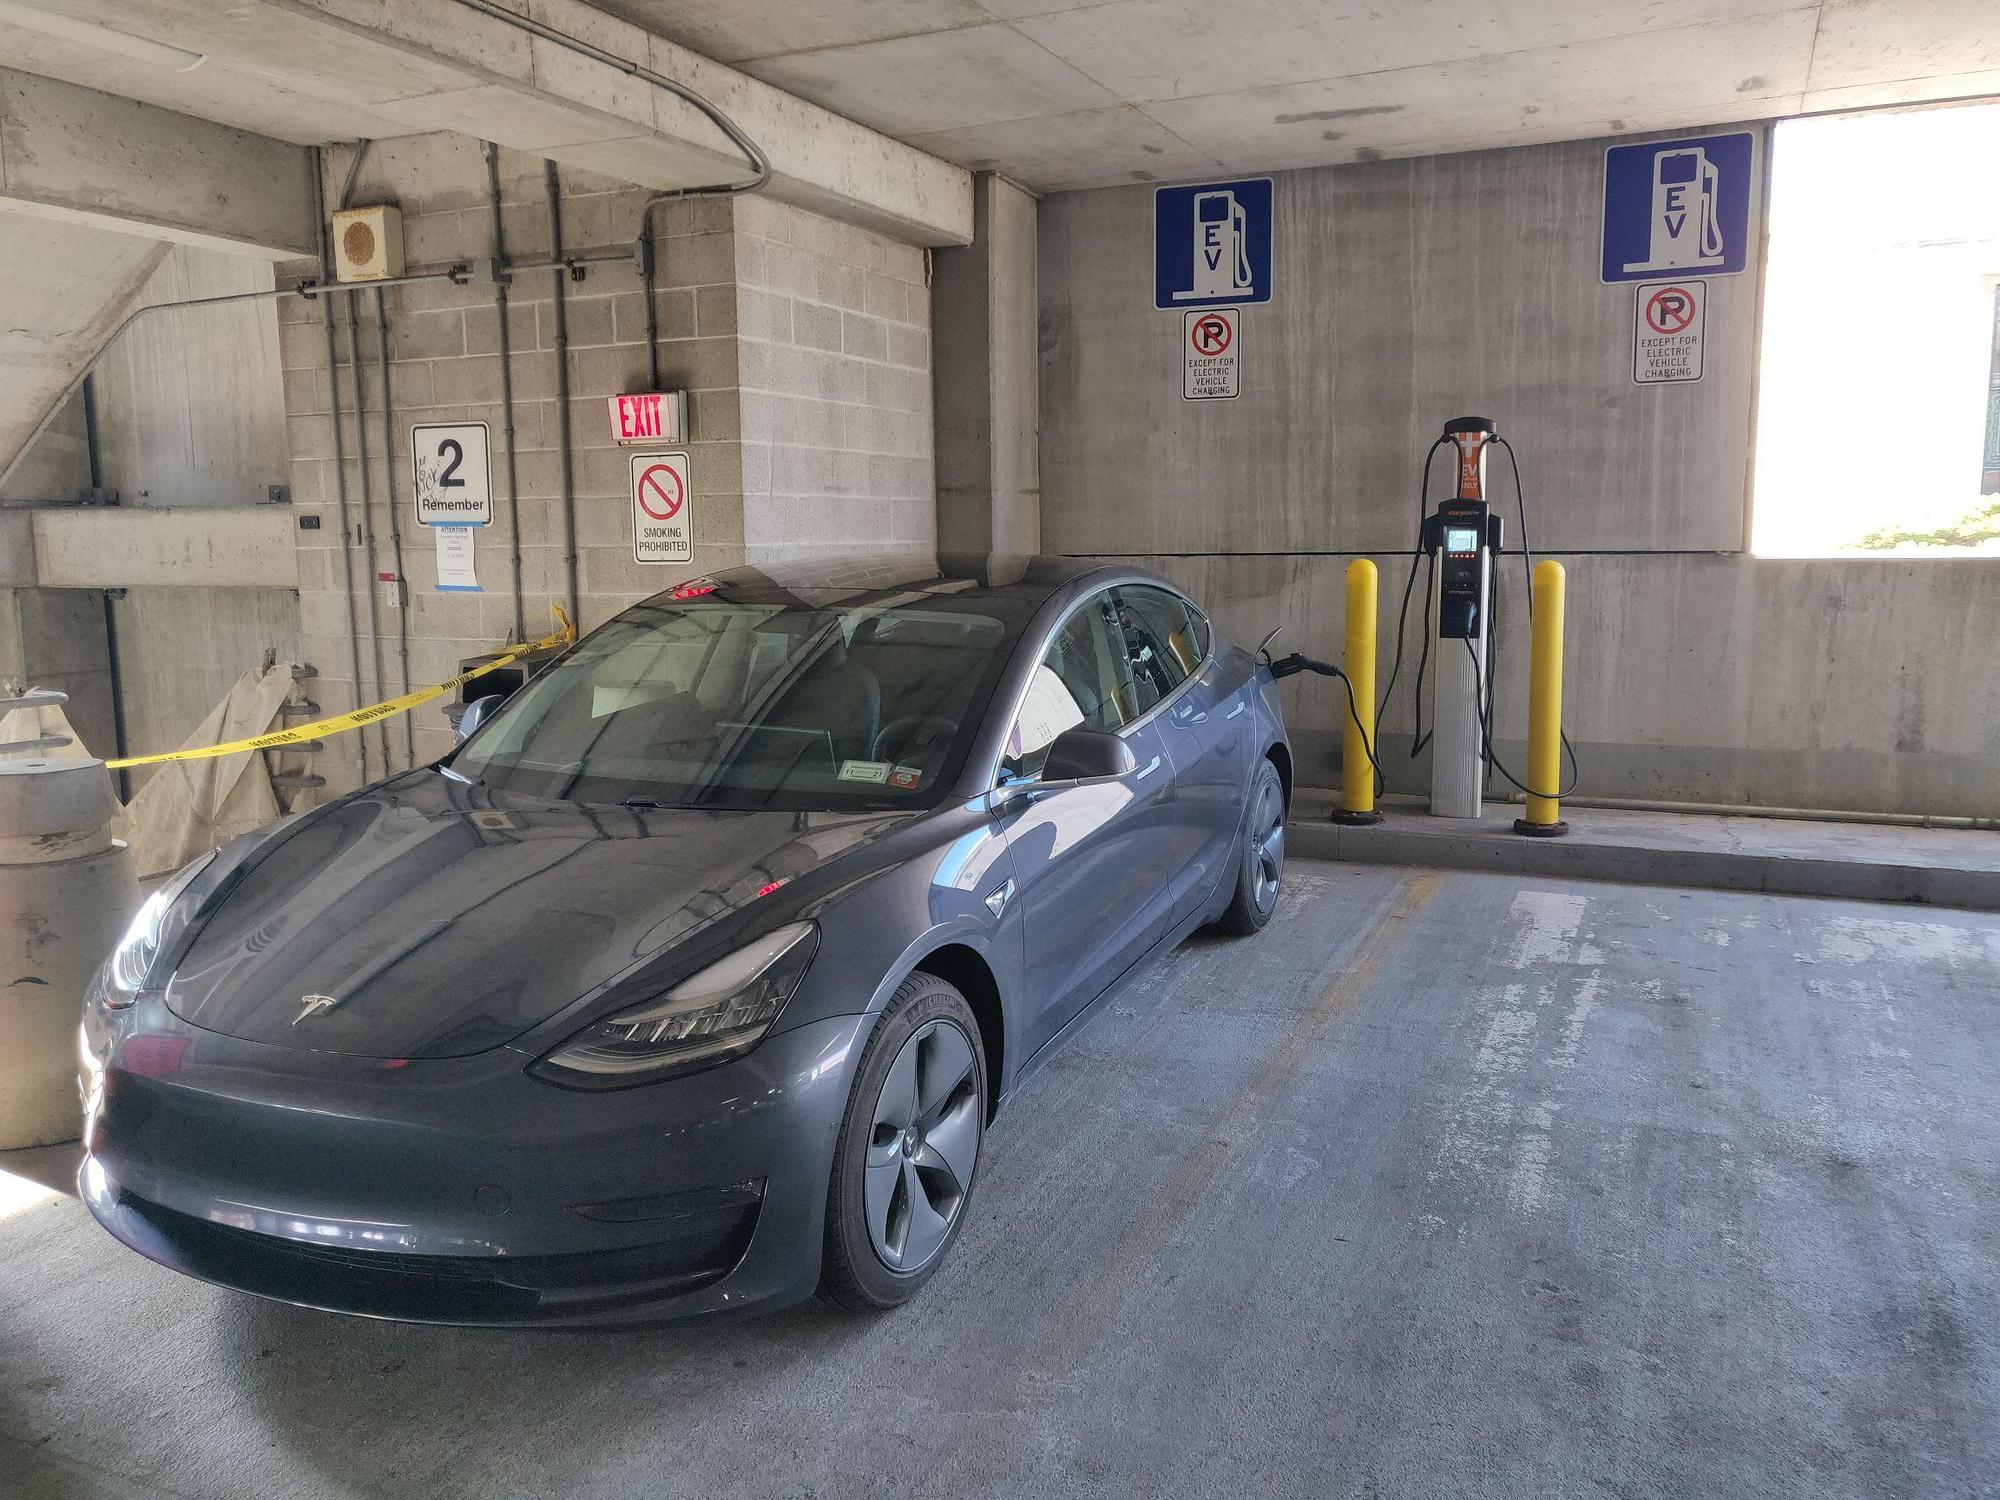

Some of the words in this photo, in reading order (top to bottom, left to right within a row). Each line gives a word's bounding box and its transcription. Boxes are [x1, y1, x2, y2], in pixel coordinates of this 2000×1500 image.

[1641, 337, 1676, 348] EXCEPT
[1679, 335, 1698, 345] FOR
[1646, 347, 1691, 358] ELECTRIC
[1189, 358, 1217, 368] EXCEPT
[1219, 357, 1235, 367] FOR
[1649, 357, 1688, 368] VEHICLE
[1193, 367, 1230, 377] ELECTRIC
[1645, 367, 1692, 379] CHARGING
[1195, 377, 1228, 386] VEHICLE
[1192, 386, 1231, 396] CHARGING
[618, 395, 662, 438] EXIT
[437, 438, 465, 488] 2
[1462, 464, 1479, 477] EV
[422, 498, 485, 511] Remember
[643, 527, 682, 538] SMOKING
[639, 541, 688, 552] PROHIBITED
